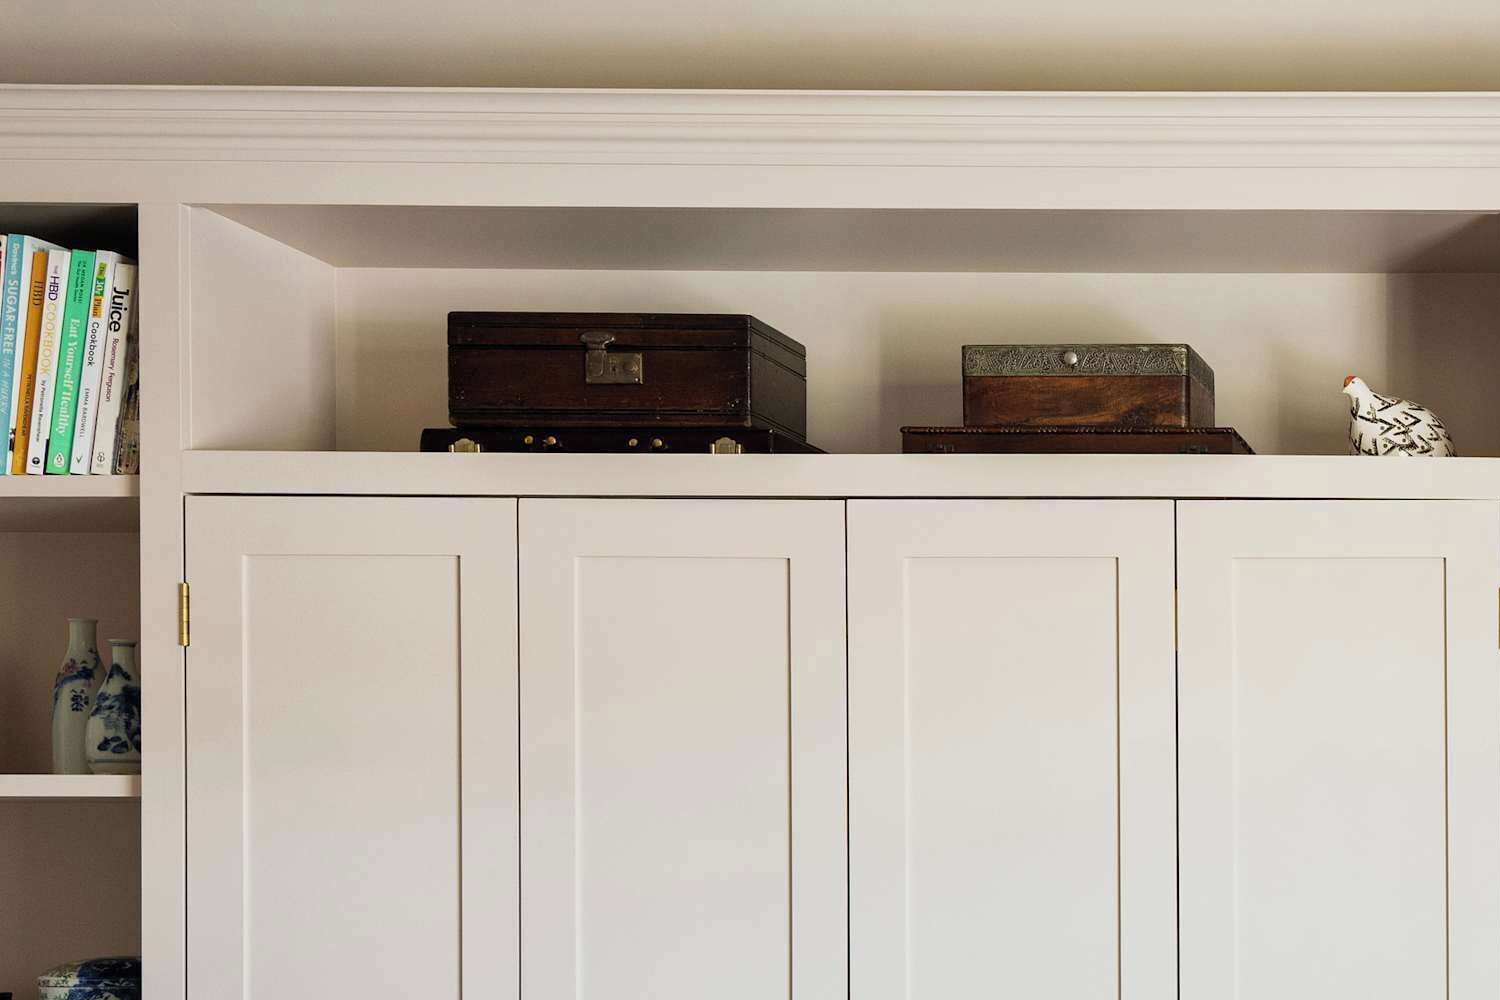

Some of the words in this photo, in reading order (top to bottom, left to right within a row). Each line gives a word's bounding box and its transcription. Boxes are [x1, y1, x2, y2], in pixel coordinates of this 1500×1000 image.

[32, 281, 45, 306] HBD
[48, 276, 60, 301] HBD
[93, 298, 103, 317] Plan
[3, 279, 22, 354] SUGAR-FREE
[69, 319, 80, 339] Eat
[109, 287, 130, 332] Juice
[40, 302, 58, 376] COOKBOOK
[87, 322, 101, 367] Cookbook
[106, 338, 120, 371] Rosemary
[63, 341, 79, 389] Yourself
[104, 372, 115, 403] Ferguson
[55, 391, 73, 437] Healthy
